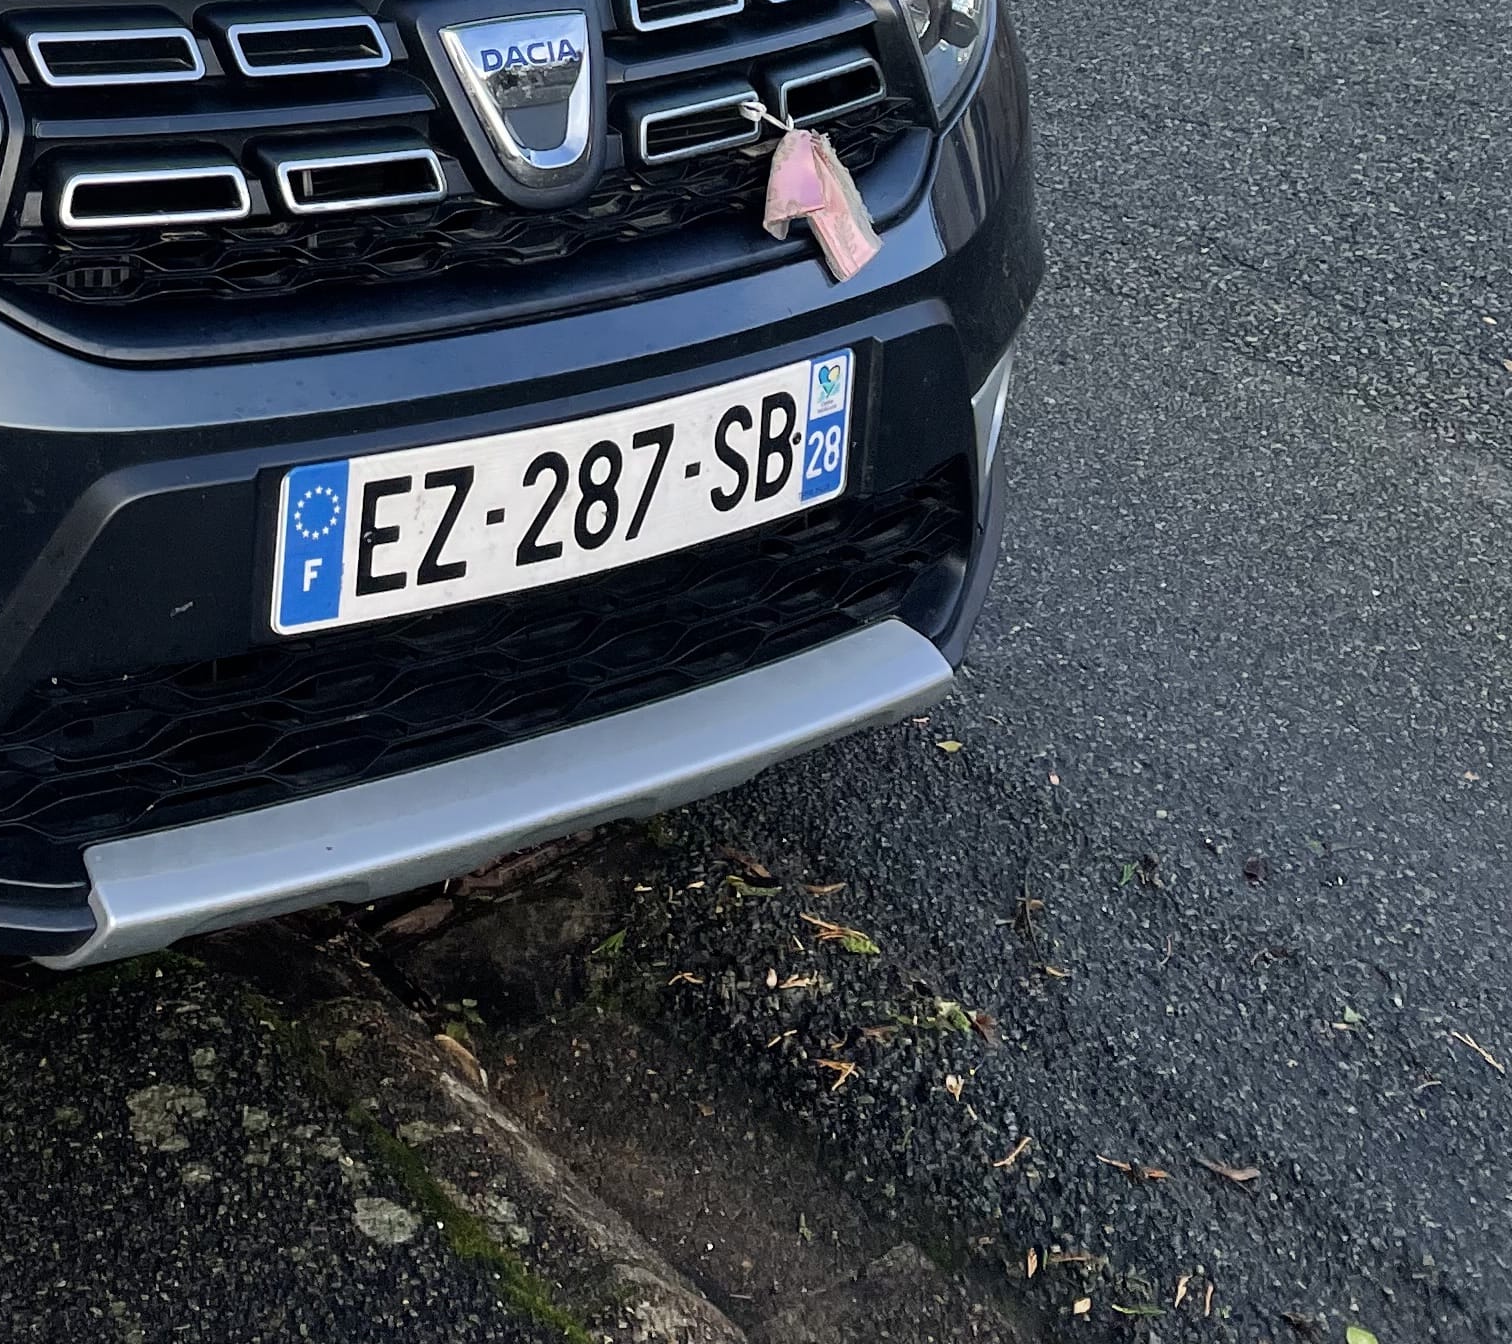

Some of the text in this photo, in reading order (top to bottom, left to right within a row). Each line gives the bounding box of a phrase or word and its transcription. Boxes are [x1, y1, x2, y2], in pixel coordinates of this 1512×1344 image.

[480, 39, 578, 72] DACIA
[806, 425, 842, 480] 28
[355, 391, 798, 598] EZ-287-SB
[303, 558, 323, 592] F
